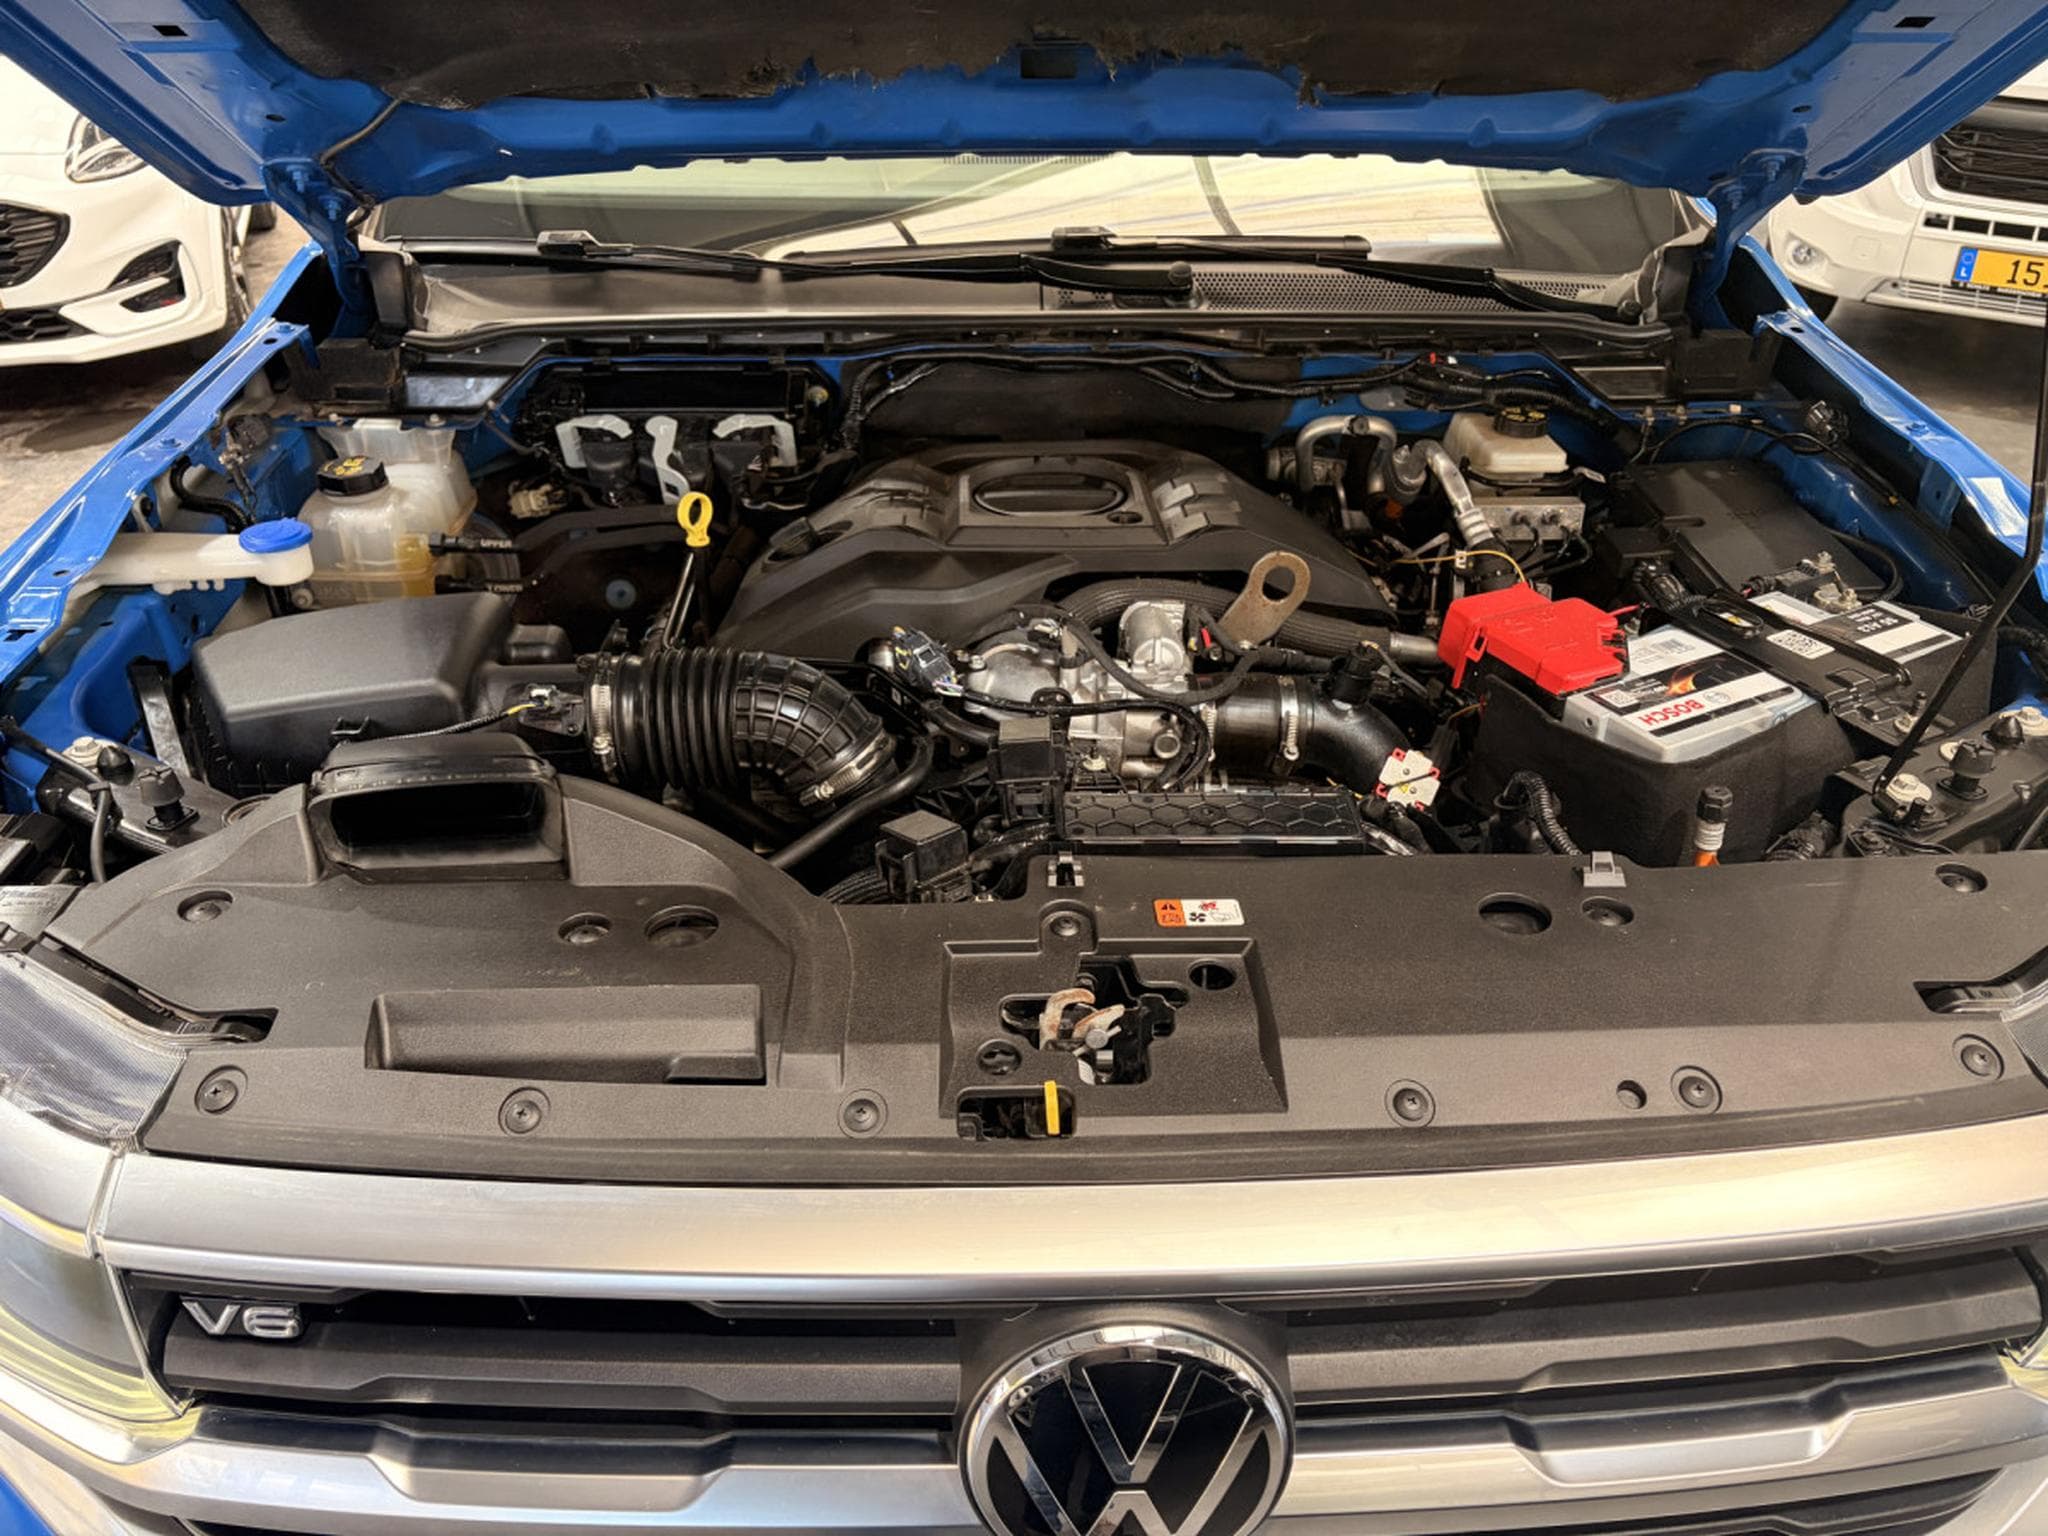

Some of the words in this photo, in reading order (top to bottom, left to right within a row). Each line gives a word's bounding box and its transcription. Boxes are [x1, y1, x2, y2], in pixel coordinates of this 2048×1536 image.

[2006, 259, 2048, 290] 15
[1638, 699, 1705, 726] BOSCH
[182, 1301, 300, 1339] V6
